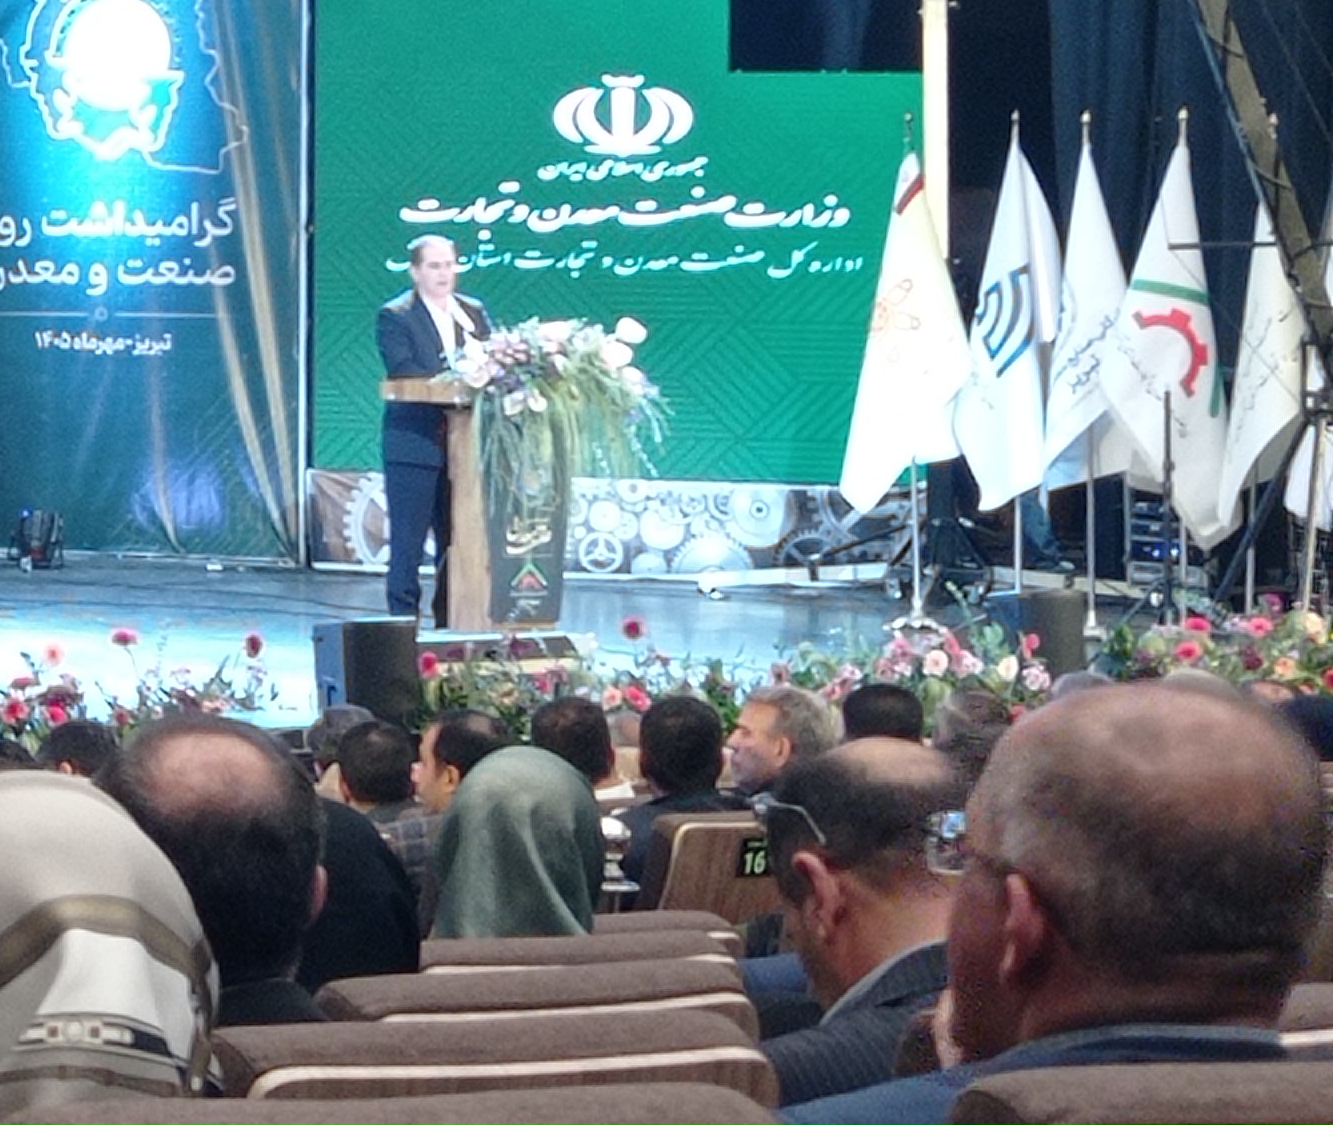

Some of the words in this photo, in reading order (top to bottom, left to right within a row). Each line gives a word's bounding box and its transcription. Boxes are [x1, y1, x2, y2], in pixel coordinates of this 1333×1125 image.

[41, 196, 238, 248] گرامیداشت
[398, 179, 521, 242] تجارت
[724, 193, 852, 229] وزارت
[85, 260, 109, 296] و
[117, 255, 237, 287] صنعت
[744, 849, 767, 875] 16
